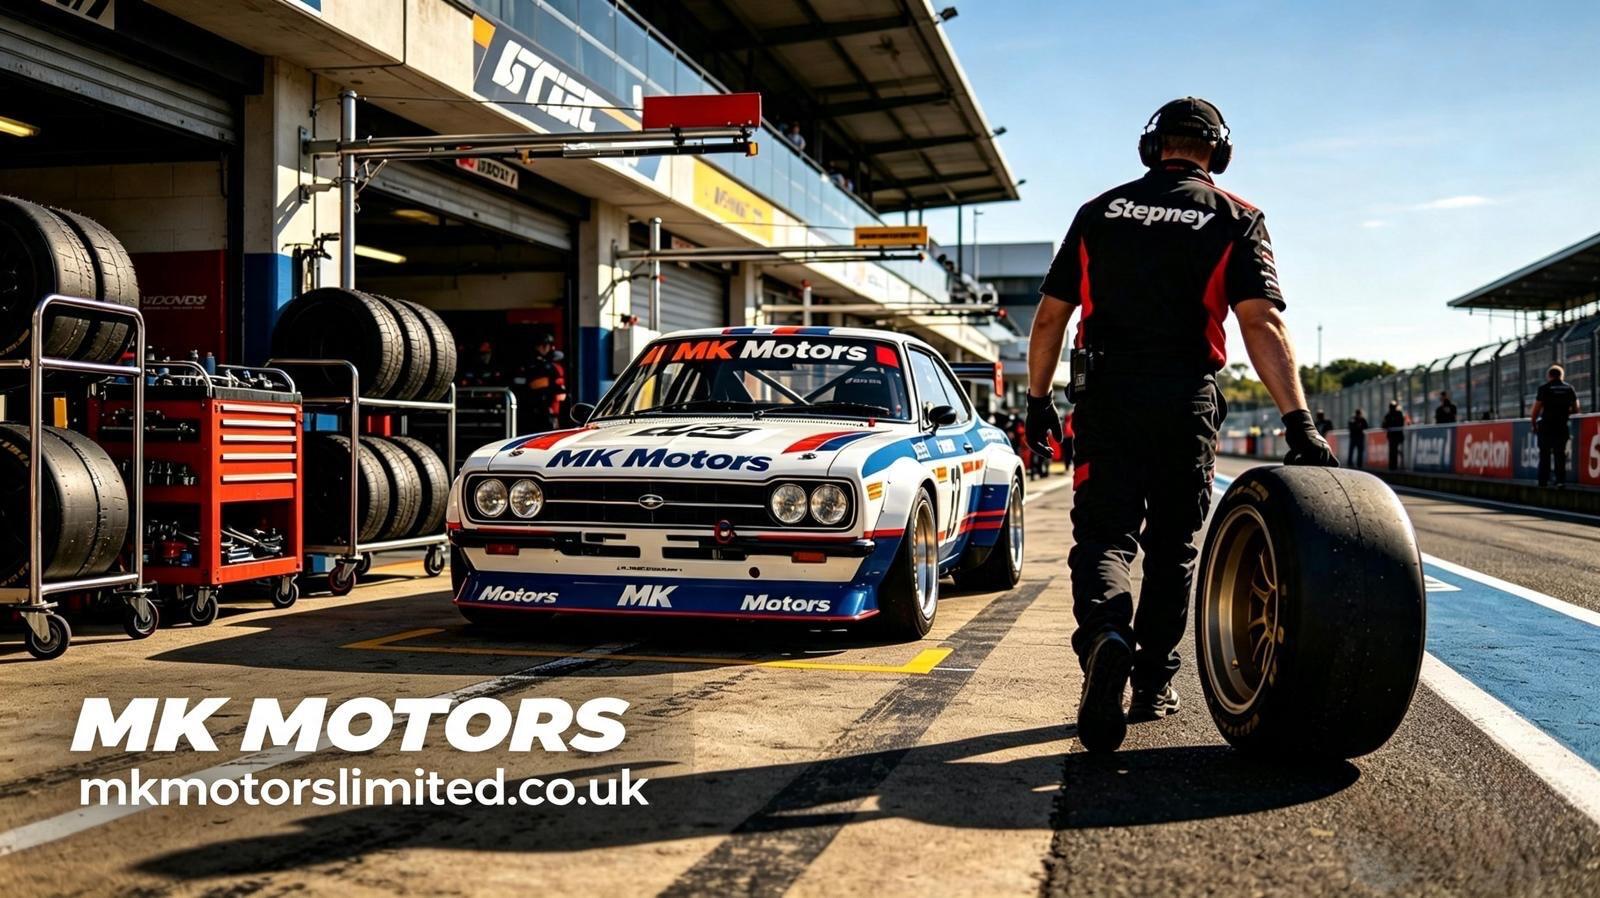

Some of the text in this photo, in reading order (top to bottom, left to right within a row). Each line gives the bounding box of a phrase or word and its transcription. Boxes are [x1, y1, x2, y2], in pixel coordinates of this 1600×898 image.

[1104, 197, 1216, 231] Stepney
[671, 339, 868, 362] MK Motors
[546, 448, 773, 473] MK Motors
[478, 585, 559, 604] Motors
[616, 584, 679, 608] MK
[740, 594, 831, 613] Motors
